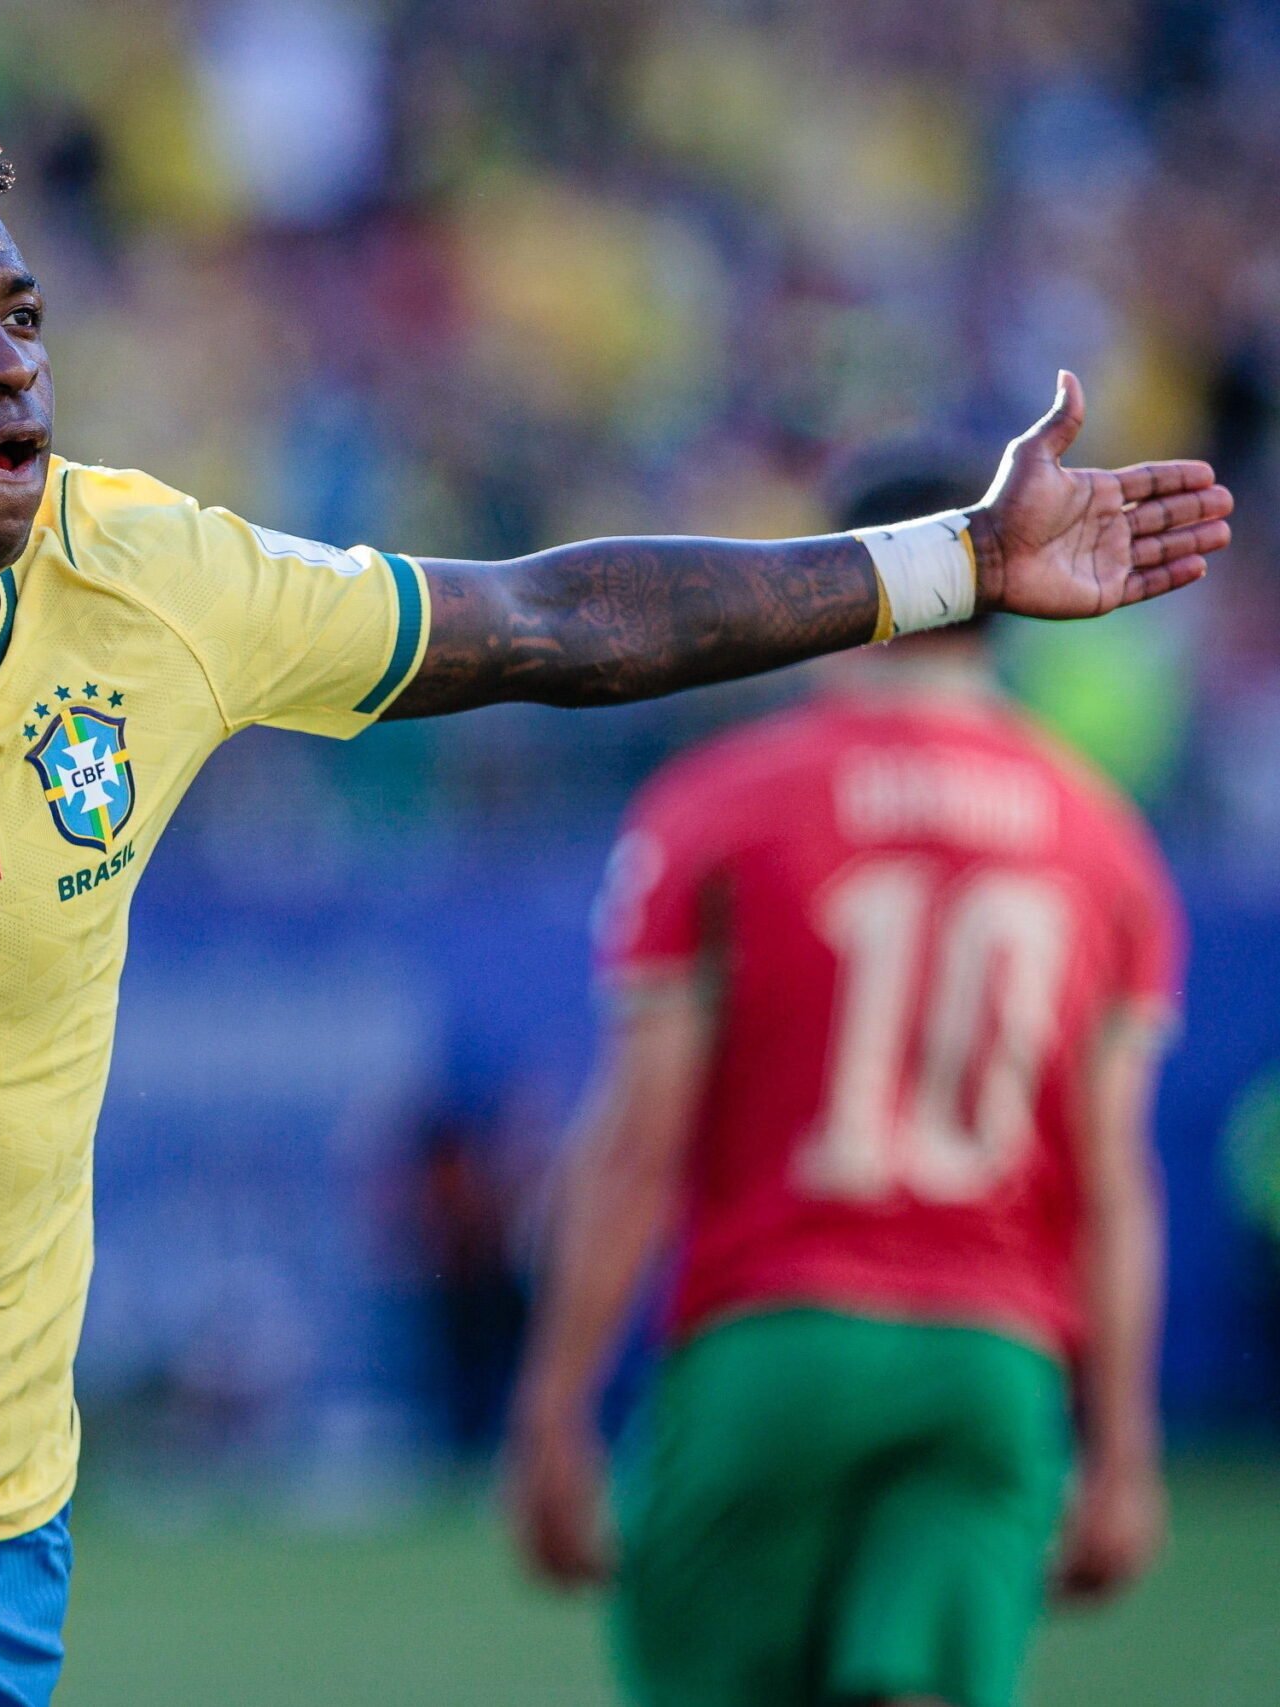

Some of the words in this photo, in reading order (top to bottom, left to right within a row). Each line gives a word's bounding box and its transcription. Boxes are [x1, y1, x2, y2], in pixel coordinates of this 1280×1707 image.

[71, 761, 105, 788] CBF
[58, 840, 136, 902] BRASIL
[792, 854, 1066, 1204] 10
